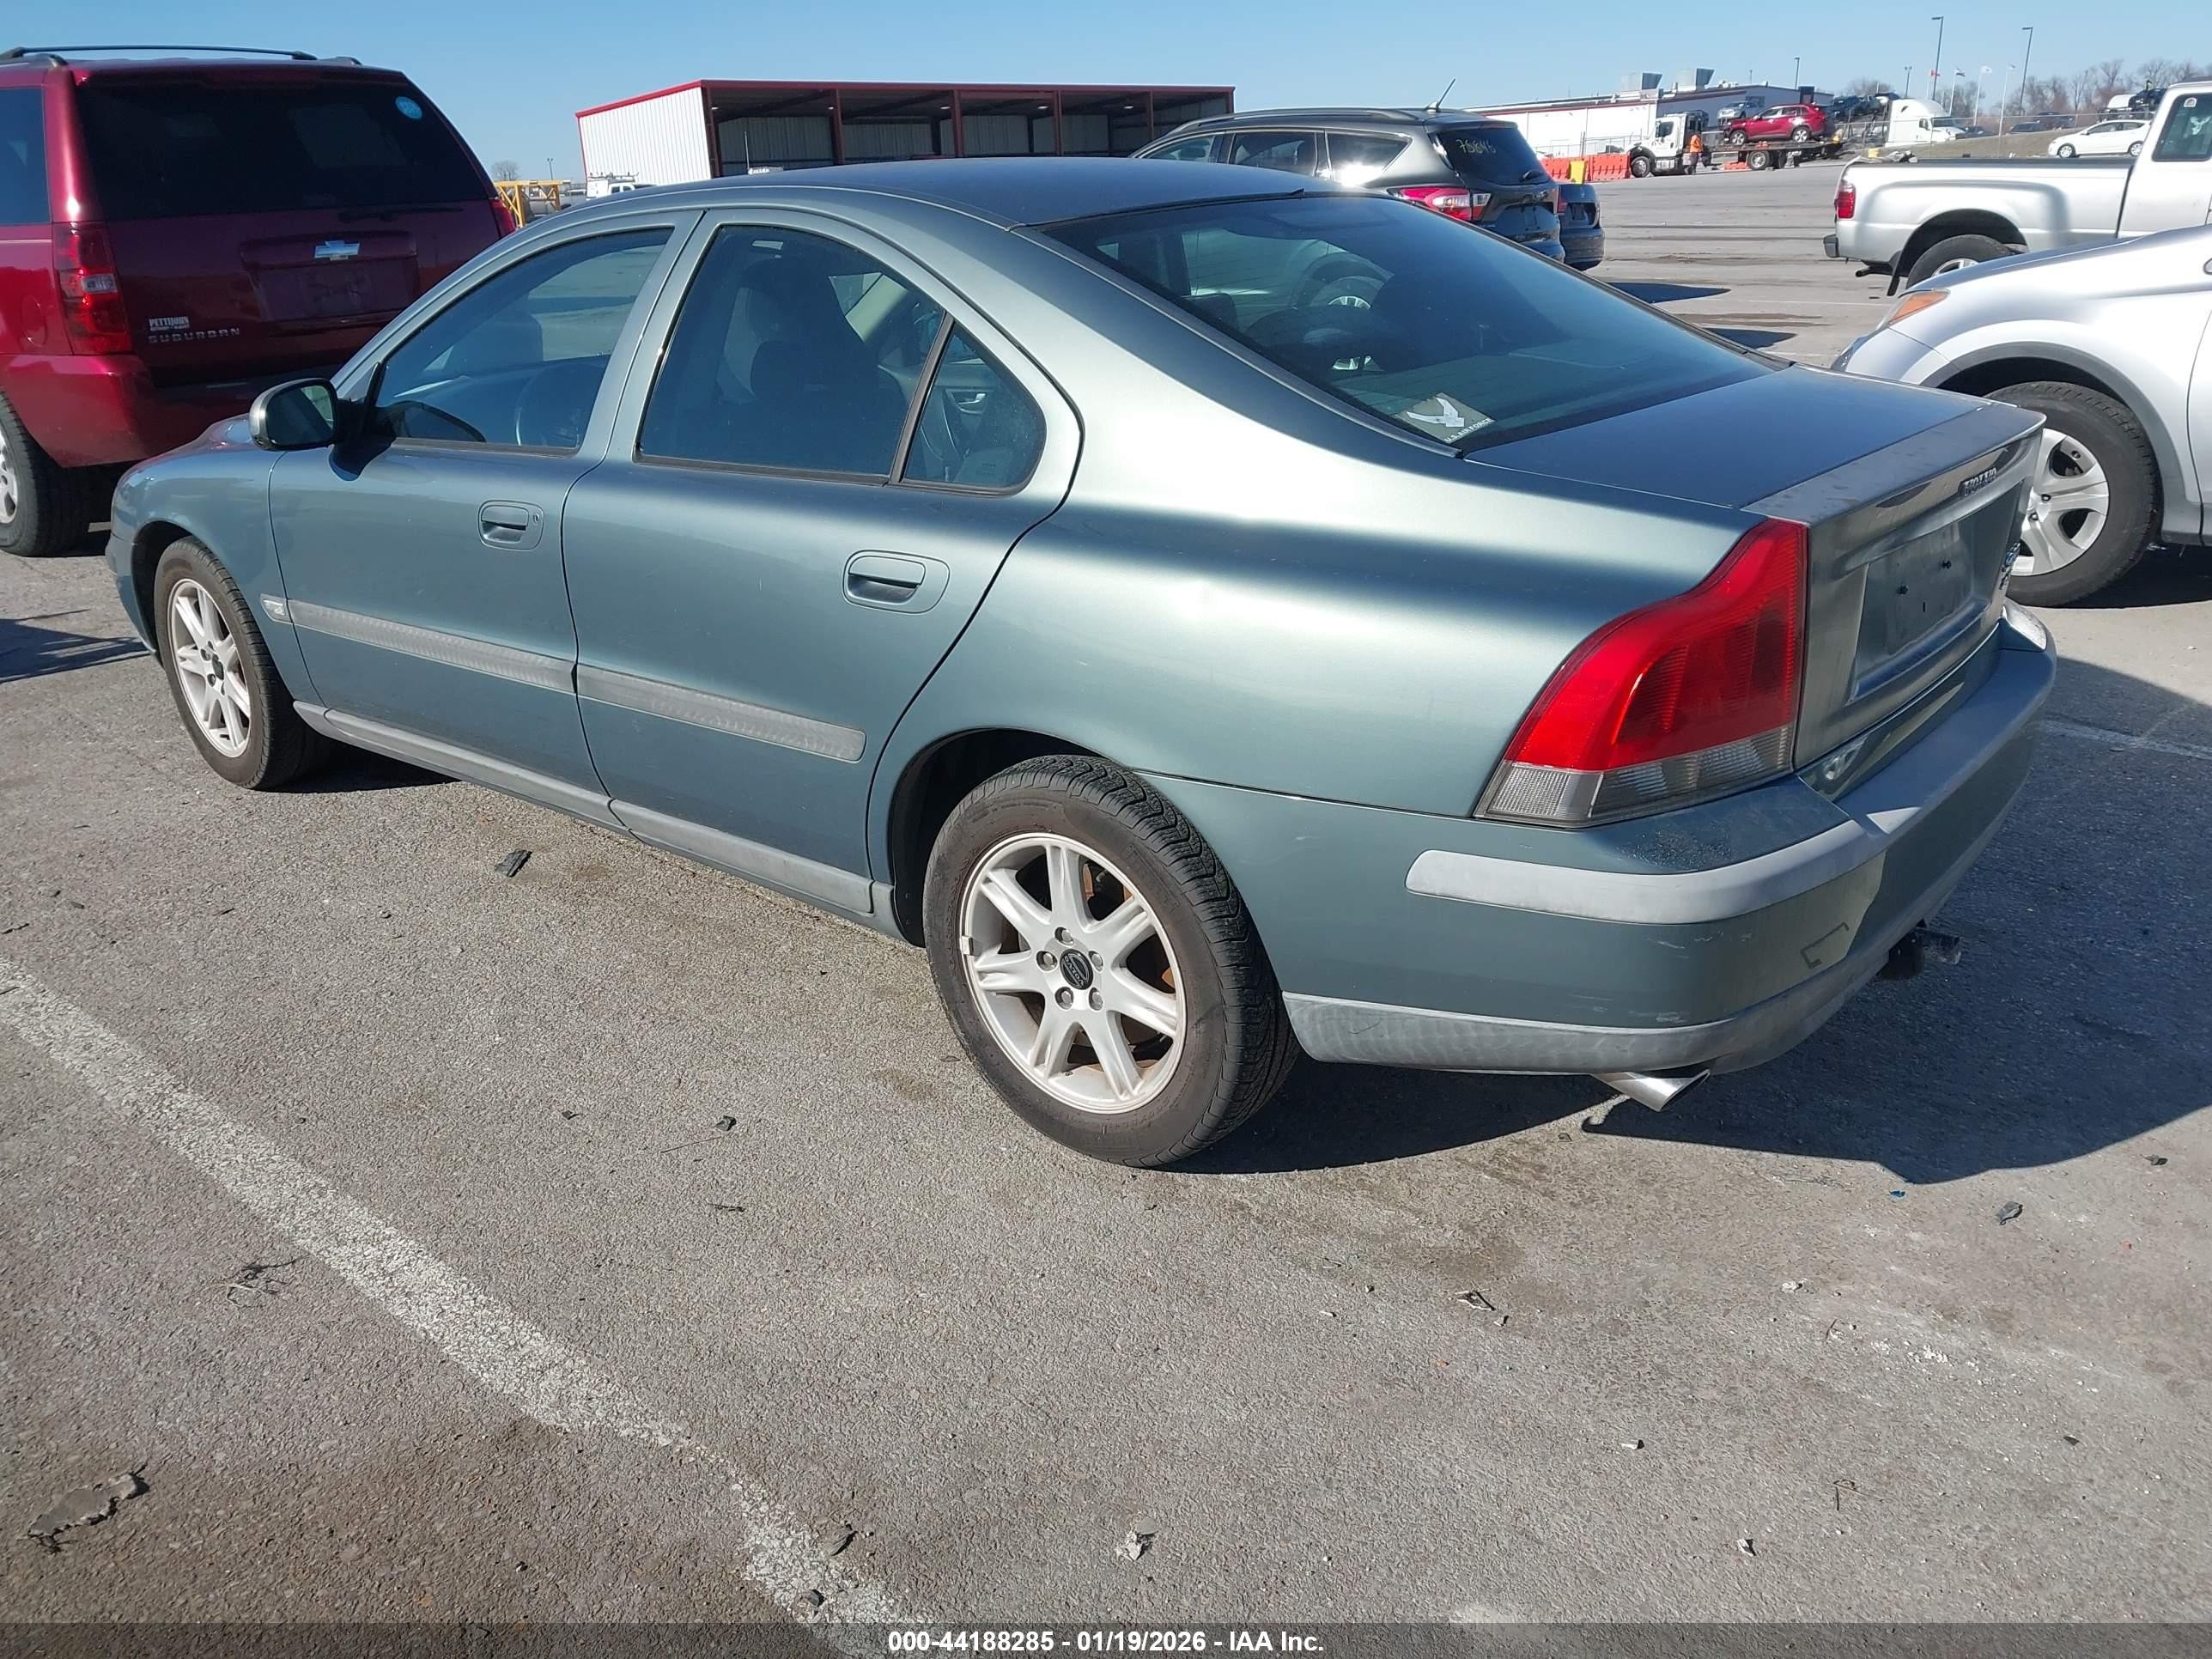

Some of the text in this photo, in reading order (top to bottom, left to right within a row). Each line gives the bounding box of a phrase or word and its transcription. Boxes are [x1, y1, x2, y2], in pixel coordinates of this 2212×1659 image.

[148, 327, 240, 343] SUBURBAN
[1458, 426, 1471, 438] AIR
[1469, 417, 1492, 432] FORCE
[1064, 955, 1084, 987] VOLVO
